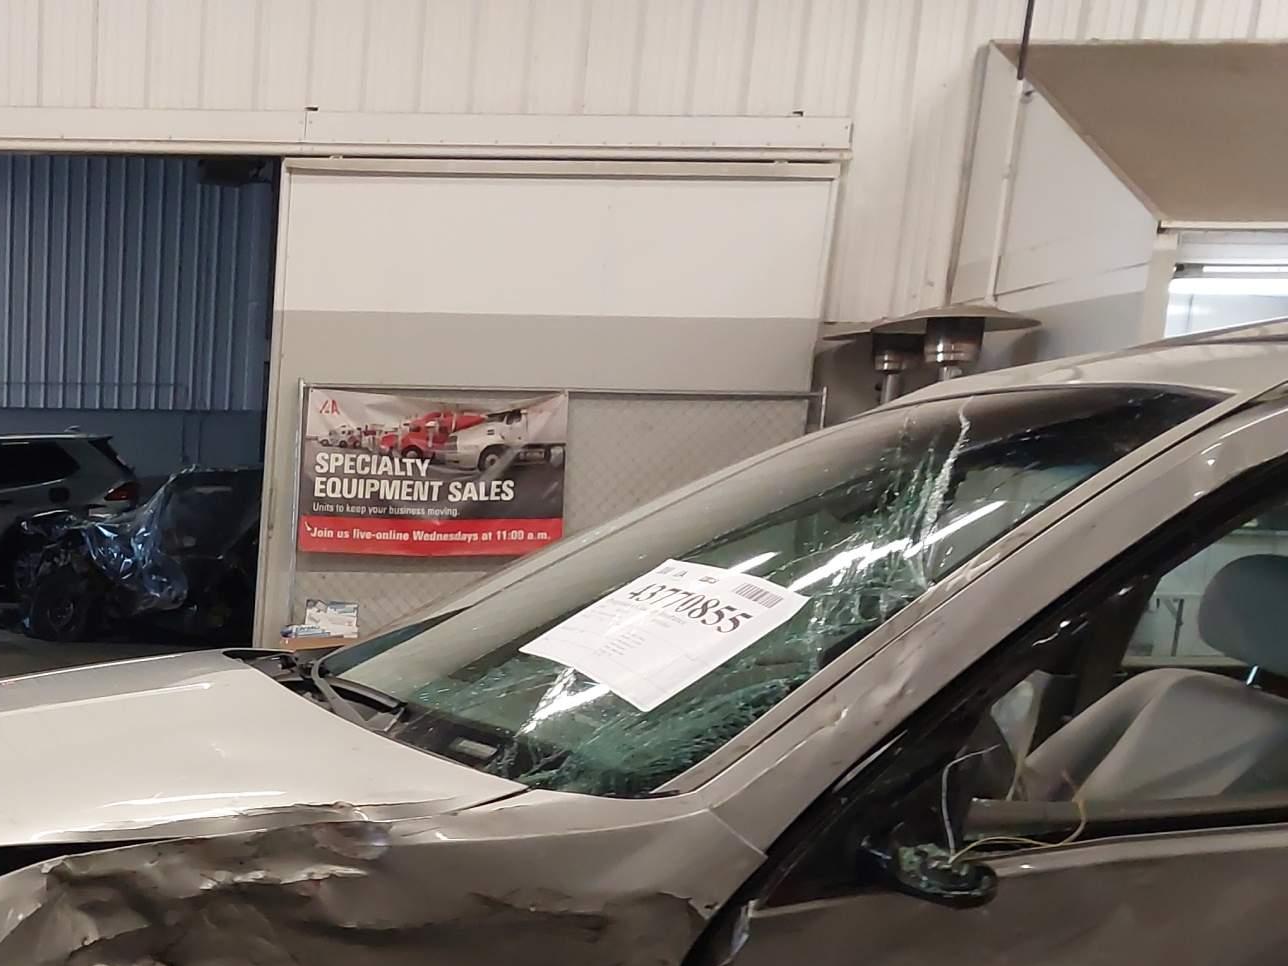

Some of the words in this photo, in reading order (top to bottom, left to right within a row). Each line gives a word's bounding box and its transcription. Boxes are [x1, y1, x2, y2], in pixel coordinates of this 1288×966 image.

[314, 452, 431, 477] SPECIALTY
[313, 477, 443, 501] EQUIPMENT
[447, 480, 515, 501] SALES
[312, 502, 334, 512] Units
[336, 503, 344, 512] to
[346, 503, 367, 515] keep
[368, 506, 387, 515] your
[389, 505, 425, 516] business
[427, 507, 460, 517] moving.
[310, 527, 333, 538] Join
[336, 530, 350, 538] us
[352, 528, 410, 541] live-online
[412, 530, 479, 543] Wednesdays
[481, 531, 492, 541] at
[496, 530, 524, 541] 11:00
[527, 531, 551, 541] a.m.
[629, 583, 753, 633] 43770855
